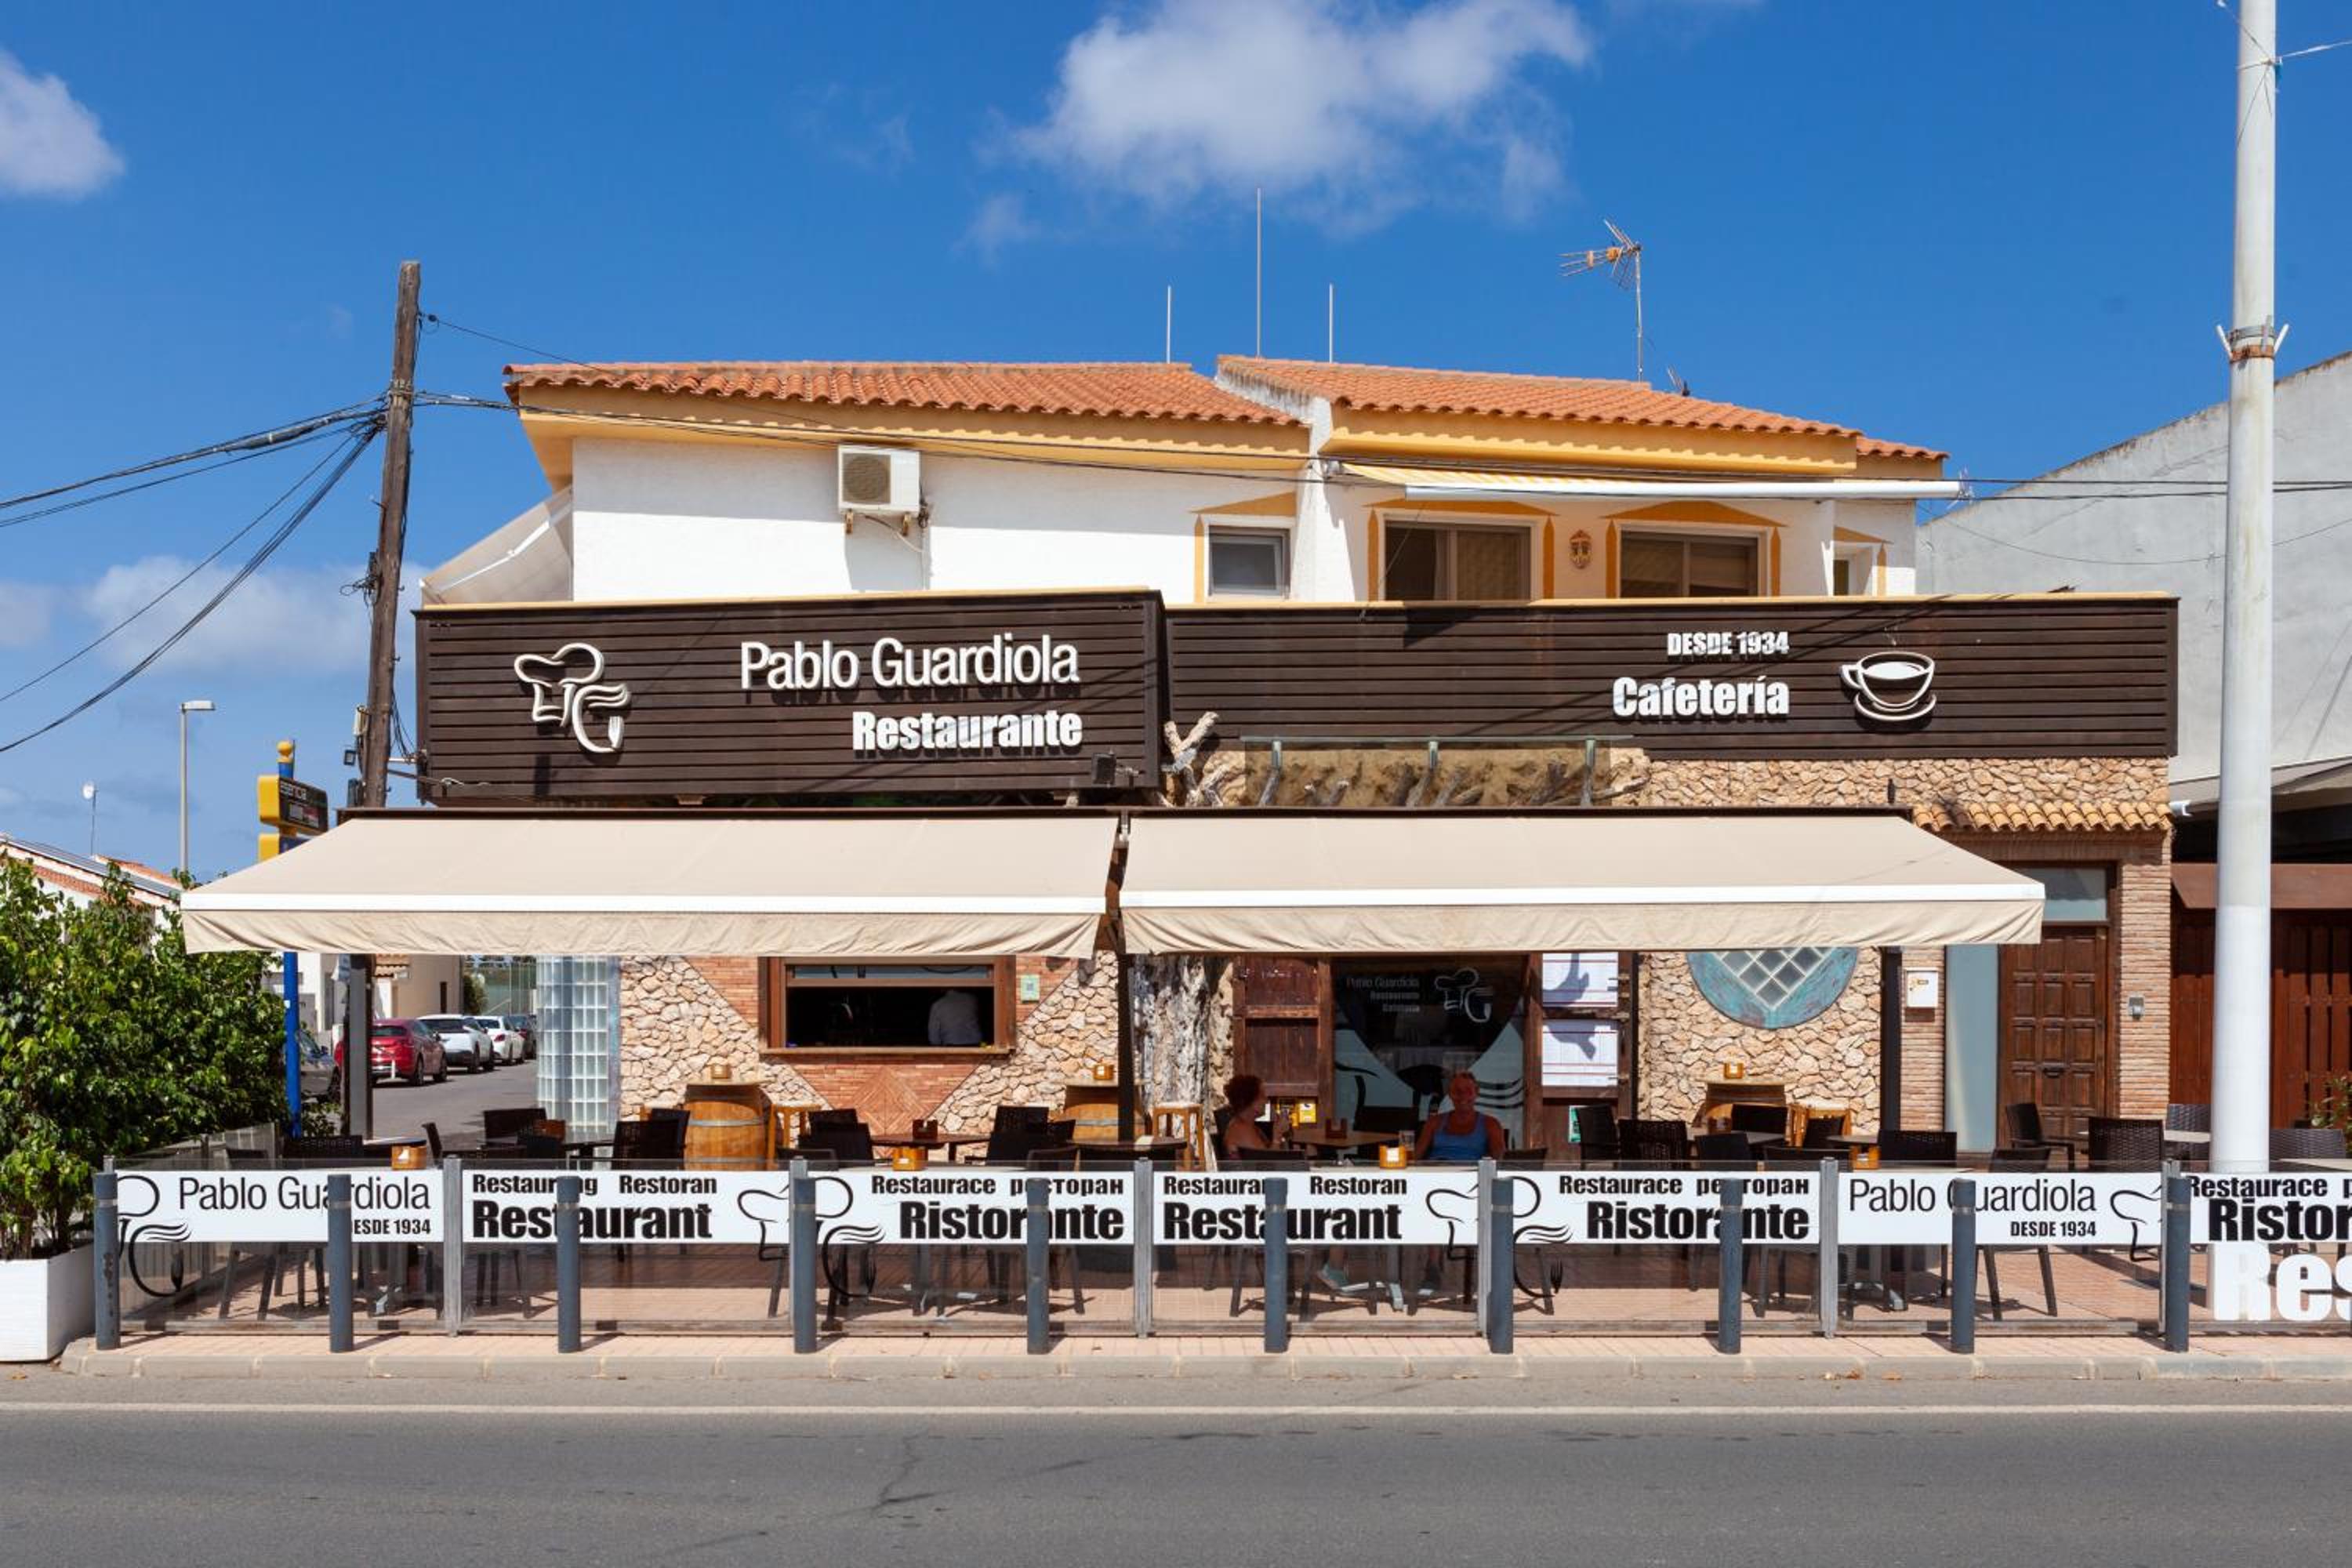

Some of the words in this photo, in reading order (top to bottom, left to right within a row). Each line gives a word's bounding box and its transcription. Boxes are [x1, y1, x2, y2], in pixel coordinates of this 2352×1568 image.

[1667, 632, 1733, 656] DESDE
[1736, 631, 1790, 655] 1934
[740, 639, 859, 690] Pablo
[871, 632, 1080, 687] Guardiola
[1612, 675, 1790, 717] Cafetería
[852, 710, 1083, 750] Restaurante
[179, 1176, 267, 1210] Pablo
[278, 1175, 430, 1210] Gudiola
[472, 1174, 597, 1196] Restaurg
[619, 1174, 717, 1194] Restoran
[872, 1175, 996, 1194] Restaurace
[1011, 1178, 1123, 1196] рторан
[1163, 1176, 1265, 1195] Restaura
[1310, 1175, 1407, 1195] Restoran
[1559, 1175, 1682, 1194] Restaurace
[1697, 1178, 1809, 1196] реторан
[1849, 1178, 1936, 1211] Pablo
[2187, 1175, 2328, 1197] Restaurace
[352, 1218, 393, 1236] ESDE
[394, 1219, 430, 1235] 1934
[472, 1200, 713, 1239] Resaurant
[2010, 1221, 2056, 1236] DESDE
[2060, 1221, 2096, 1236] 1934
